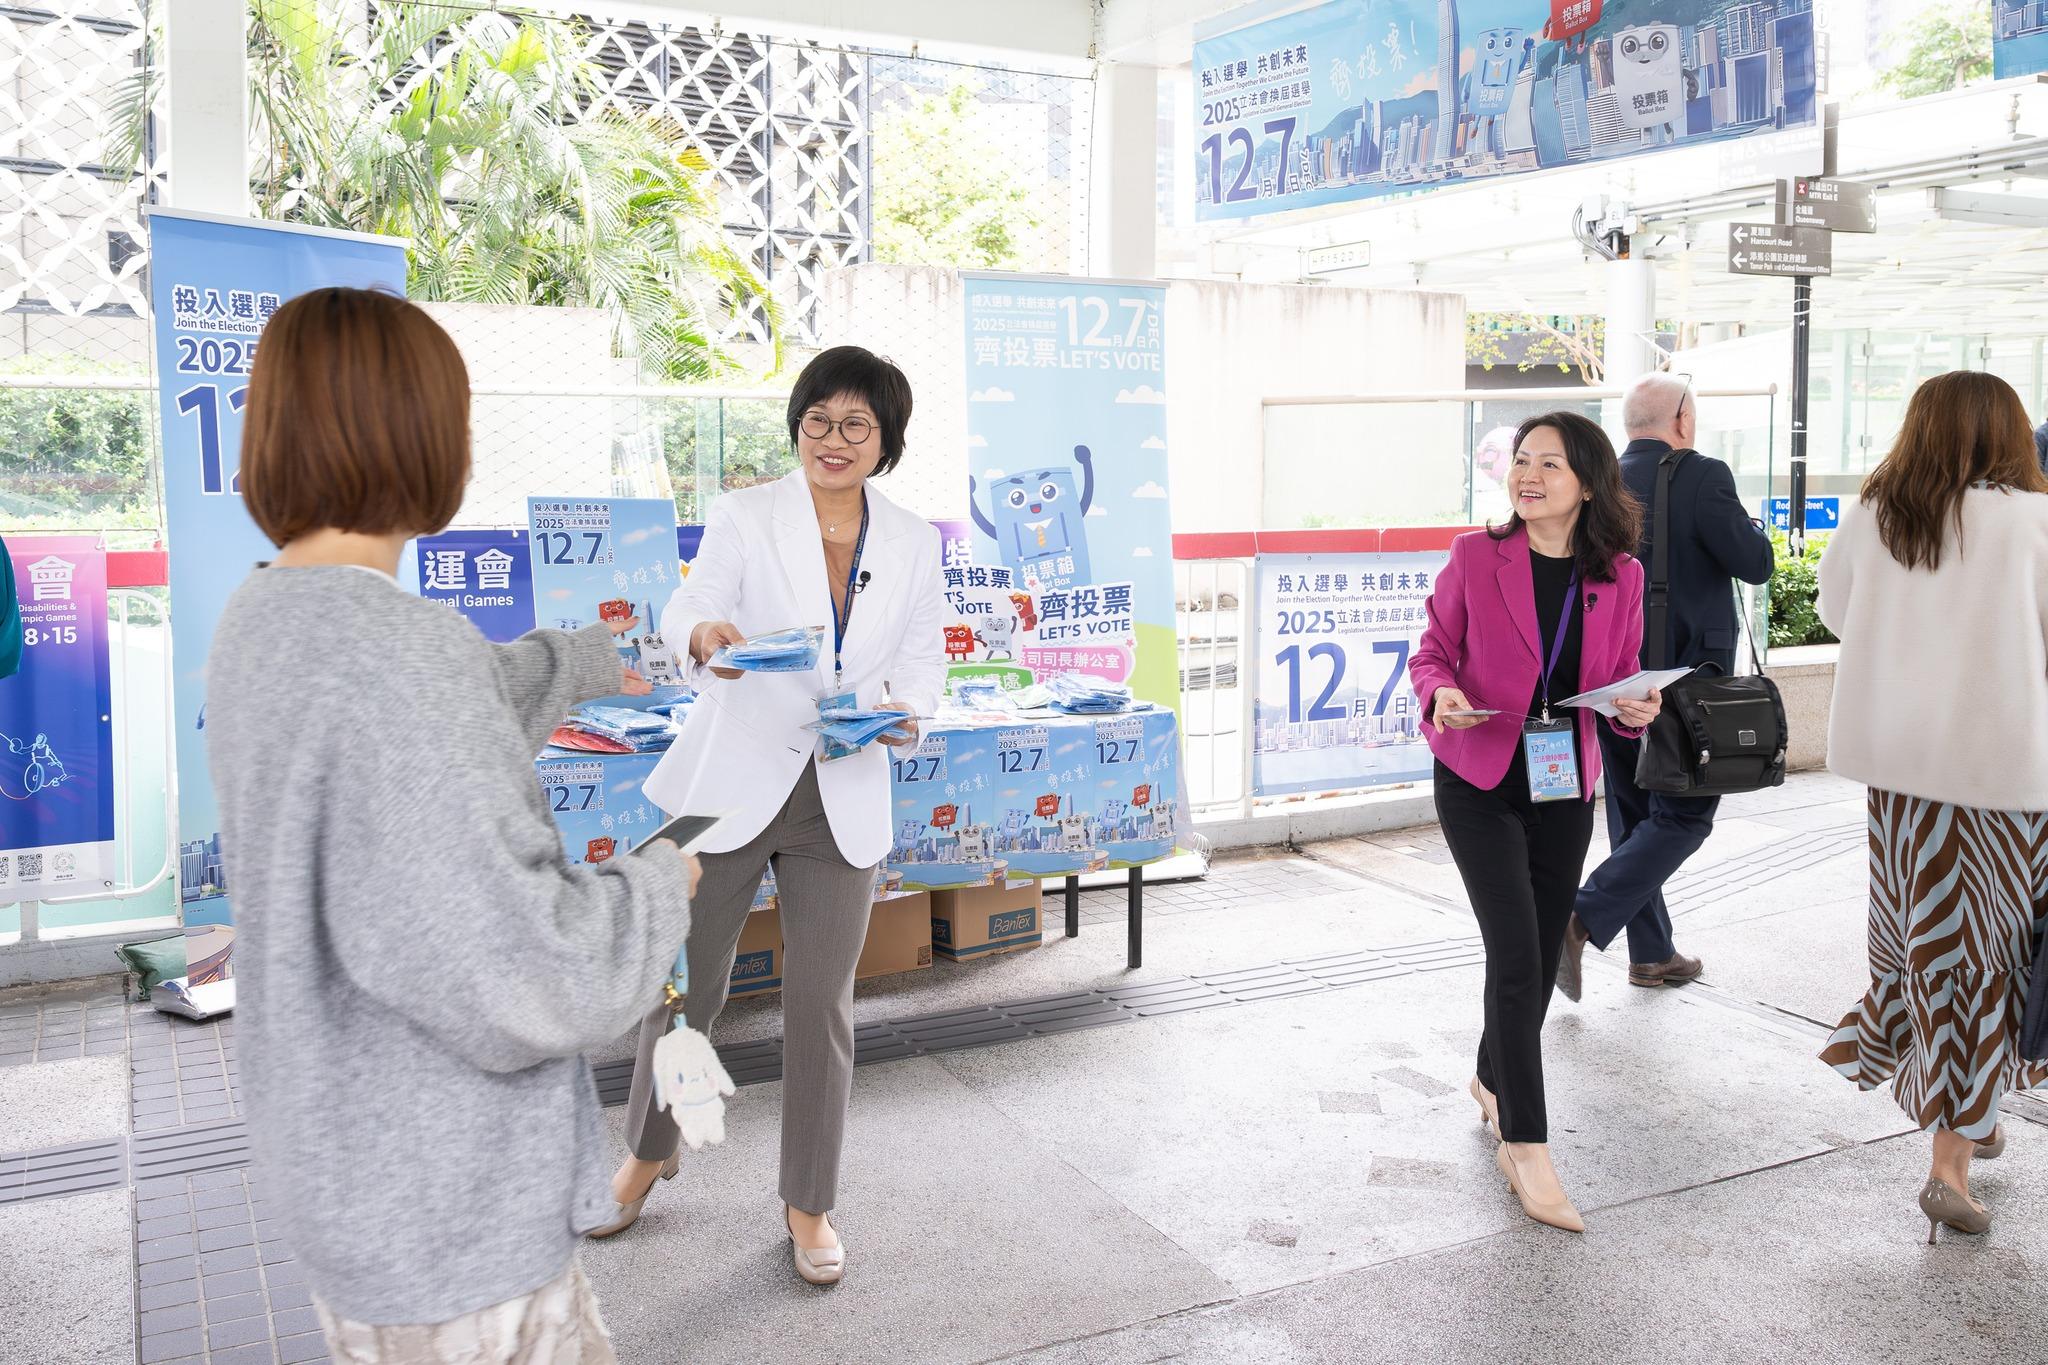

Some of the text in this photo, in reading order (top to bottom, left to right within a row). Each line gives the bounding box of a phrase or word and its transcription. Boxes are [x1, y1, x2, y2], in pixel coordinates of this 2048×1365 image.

[1563, 0, 1591, 23] 投票箱
[1202, 44, 1307, 88] 投入選舉 共創未來
[1236, 78, 1259, 92] Together
[1267, 73, 1284, 83] Create
[1283, 69, 1292, 78] the
[1292, 66, 1309, 76] Future
[1203, 80, 1311, 126] 2025 立法會換屆選舉
[1632, 89, 1669, 109] 投票箱
[1809, 191, 1822, 200] MTR
[1823, 192, 1833, 201] Exit
[1795, 215, 1826, 225] Queensway
[1750, 237, 1793, 247] Harcourt Road
[1750, 262, 1764, 270] Tamar
[1763, 263, 1773, 271] Park
[1781, 264, 1796, 272] Central
[1795, 264, 1818, 273] Government
[1817, 265, 1830, 274] Offices
[175, 287, 278, 318] 投入選舉
[176, 317, 198, 329] Join
[199, 318, 216, 330] the
[218, 320, 258, 333] Election
[973, 317, 1006, 331] 2025
[1147, 314, 1160, 350] DEC
[973, 335, 1059, 369] 齊投票
[1060, 349, 1161, 372] LET'S VOTE
[534, 503, 609, 512] 投入選舉 共創未來
[535, 518, 564, 529] 2025
[424, 548, 514, 590] 運會
[1021, 555, 1075, 579] 投票箱
[26, 555, 76, 601] 會
[943, 566, 1011, 589] 齊投票
[1055, 577, 1071, 587] Box
[1277, 571, 1429, 593] 投入選舉 共創未來
[464, 594, 514, 607] Games
[944, 591, 965, 603] T'S
[1040, 584, 1132, 623] 齊投票
[1276, 592, 1427, 605] Join the Election Together We Create the Futur
[18, 602, 77, 612] Disabilities &
[955, 602, 993, 615] VOTE
[21, 613, 77, 624] mpic Games
[1277, 606, 1427, 635] 2025 立法會換屆選舉
[24, 626, 77, 646] 8 15
[1040, 619, 1131, 641] LET'S VOTE
[1338, 627, 1365, 635] Legislative
[1017, 652, 1120, 669] 司司長辦公室
[998, 740, 1018, 749] 2025
[541, 774, 565, 785] 2025
[730, 956, 769, 977] antex
